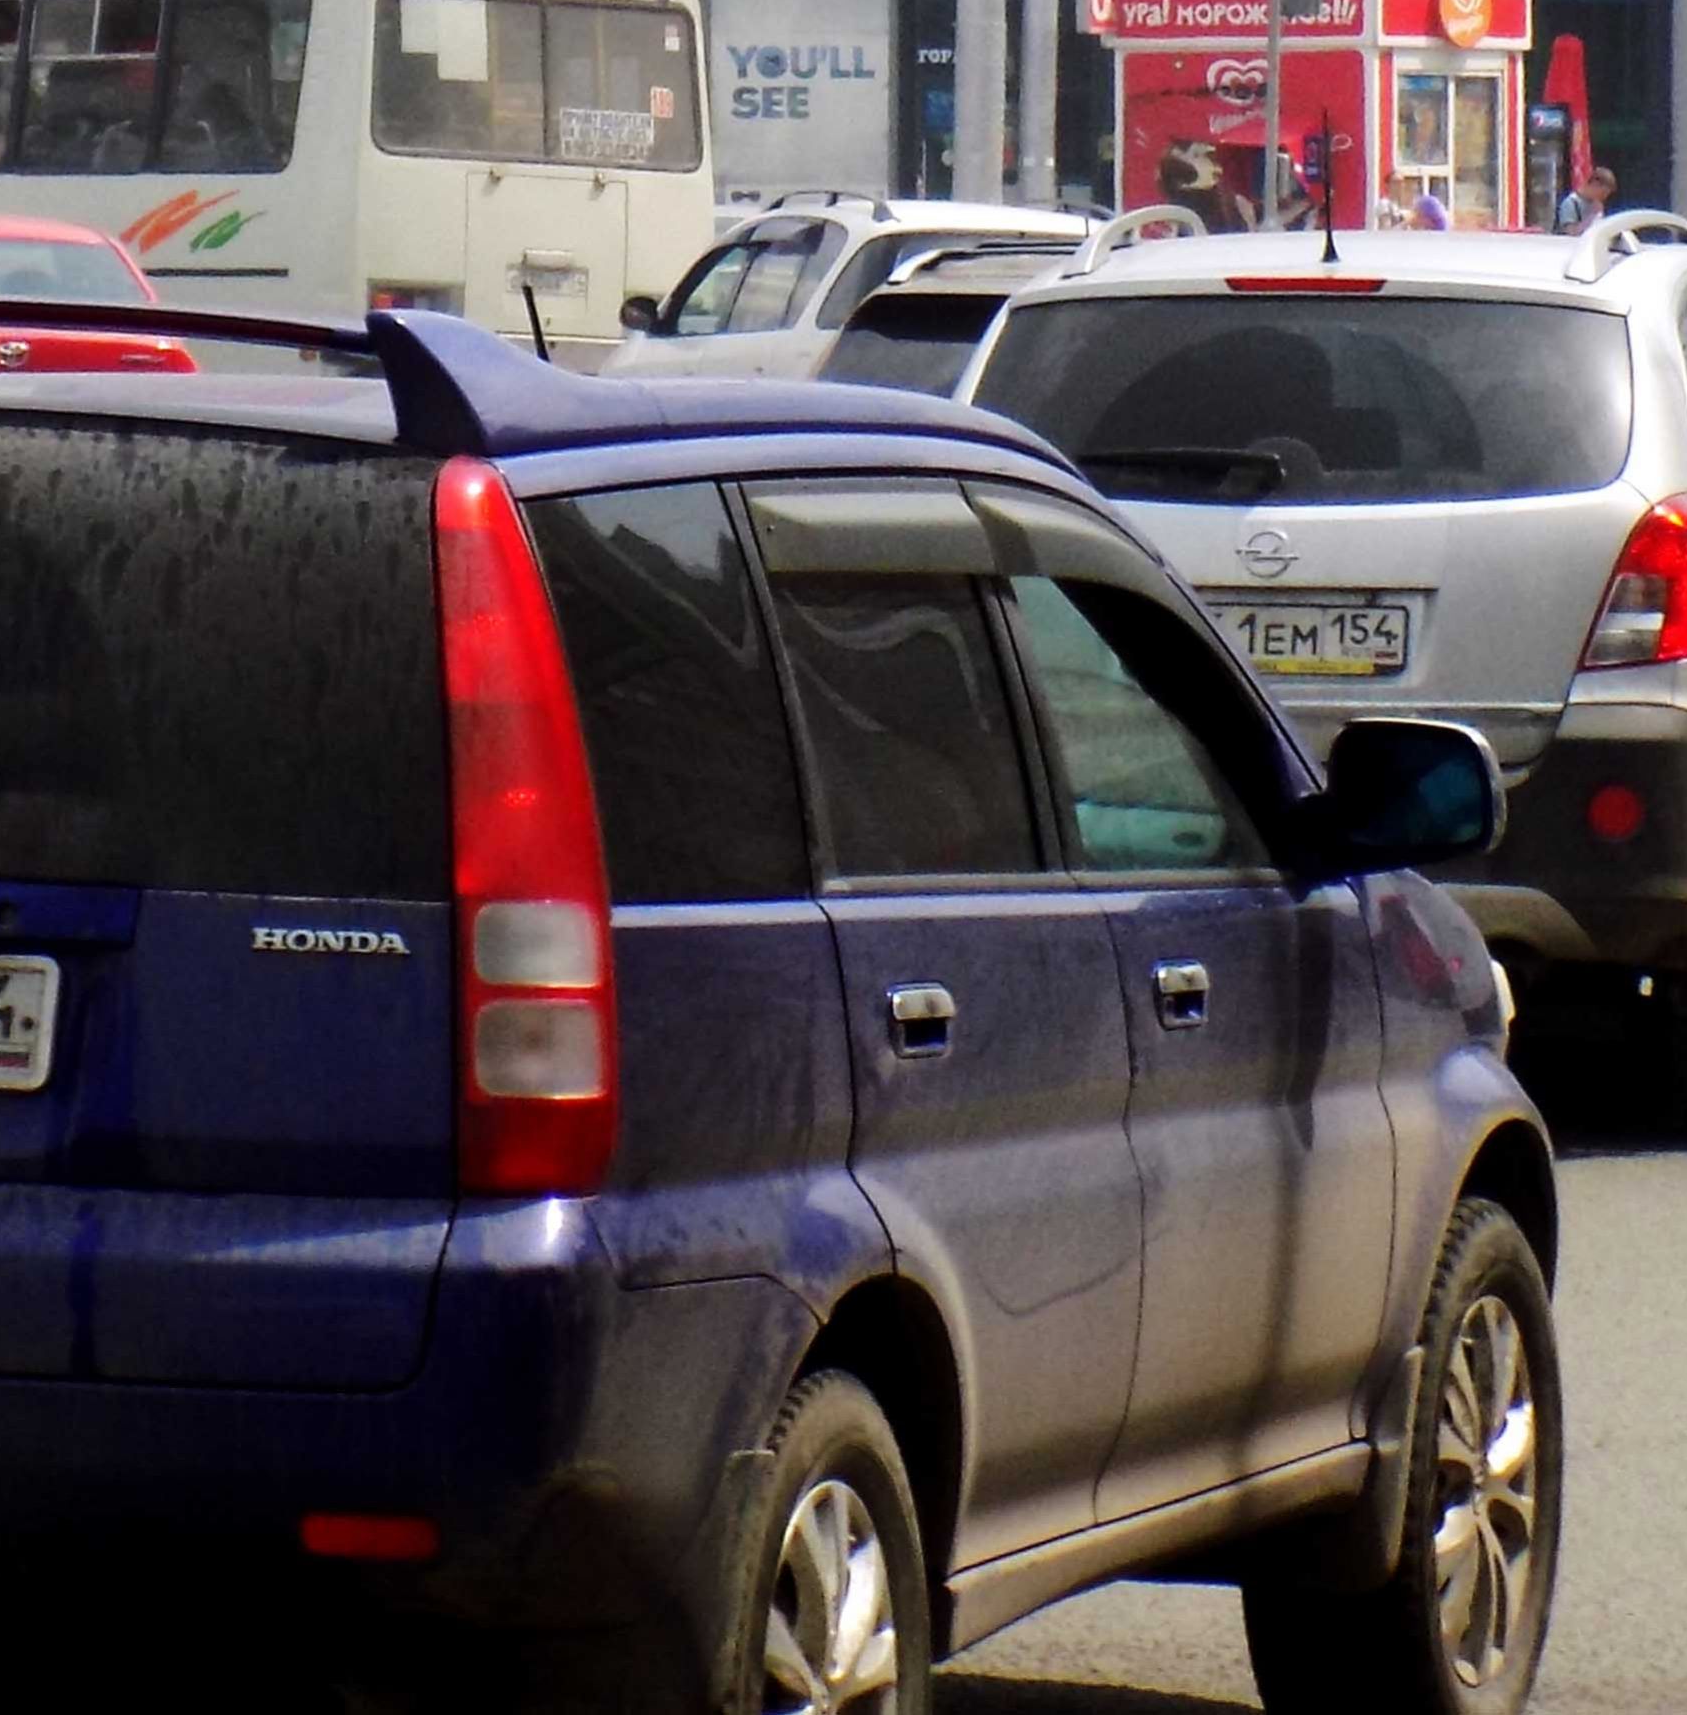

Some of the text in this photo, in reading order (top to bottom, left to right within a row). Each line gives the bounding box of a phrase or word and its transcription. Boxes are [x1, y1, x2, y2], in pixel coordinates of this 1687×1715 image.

[726, 46, 875, 79] YOU'LL
[917, 49, 954, 64] ГОР
[731, 86, 810, 119] SEE
[1211, 612, 1395, 656] 1ЕМ 154
[253, 926, 411, 956] HONDA
